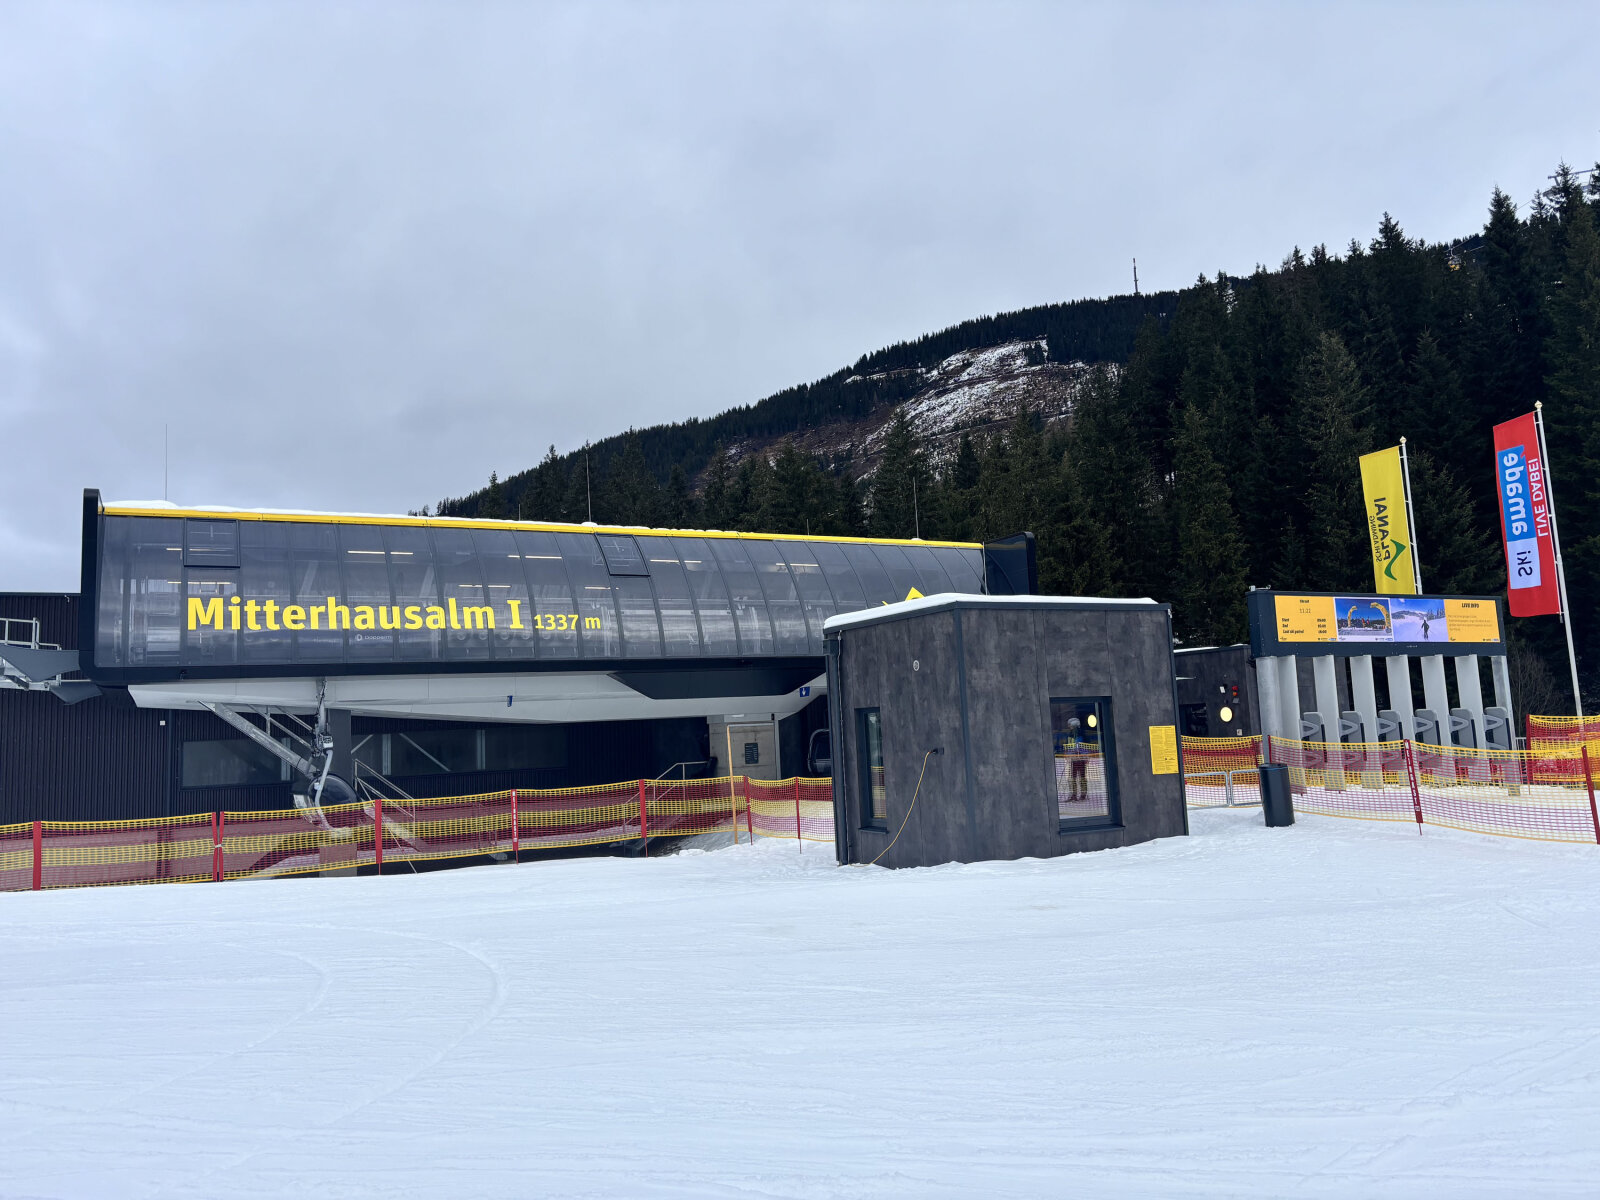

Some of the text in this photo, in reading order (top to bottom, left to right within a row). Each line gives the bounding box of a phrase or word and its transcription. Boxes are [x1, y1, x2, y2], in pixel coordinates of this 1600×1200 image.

[187, 596, 601, 631] Mitterhausalm I 1337 m
